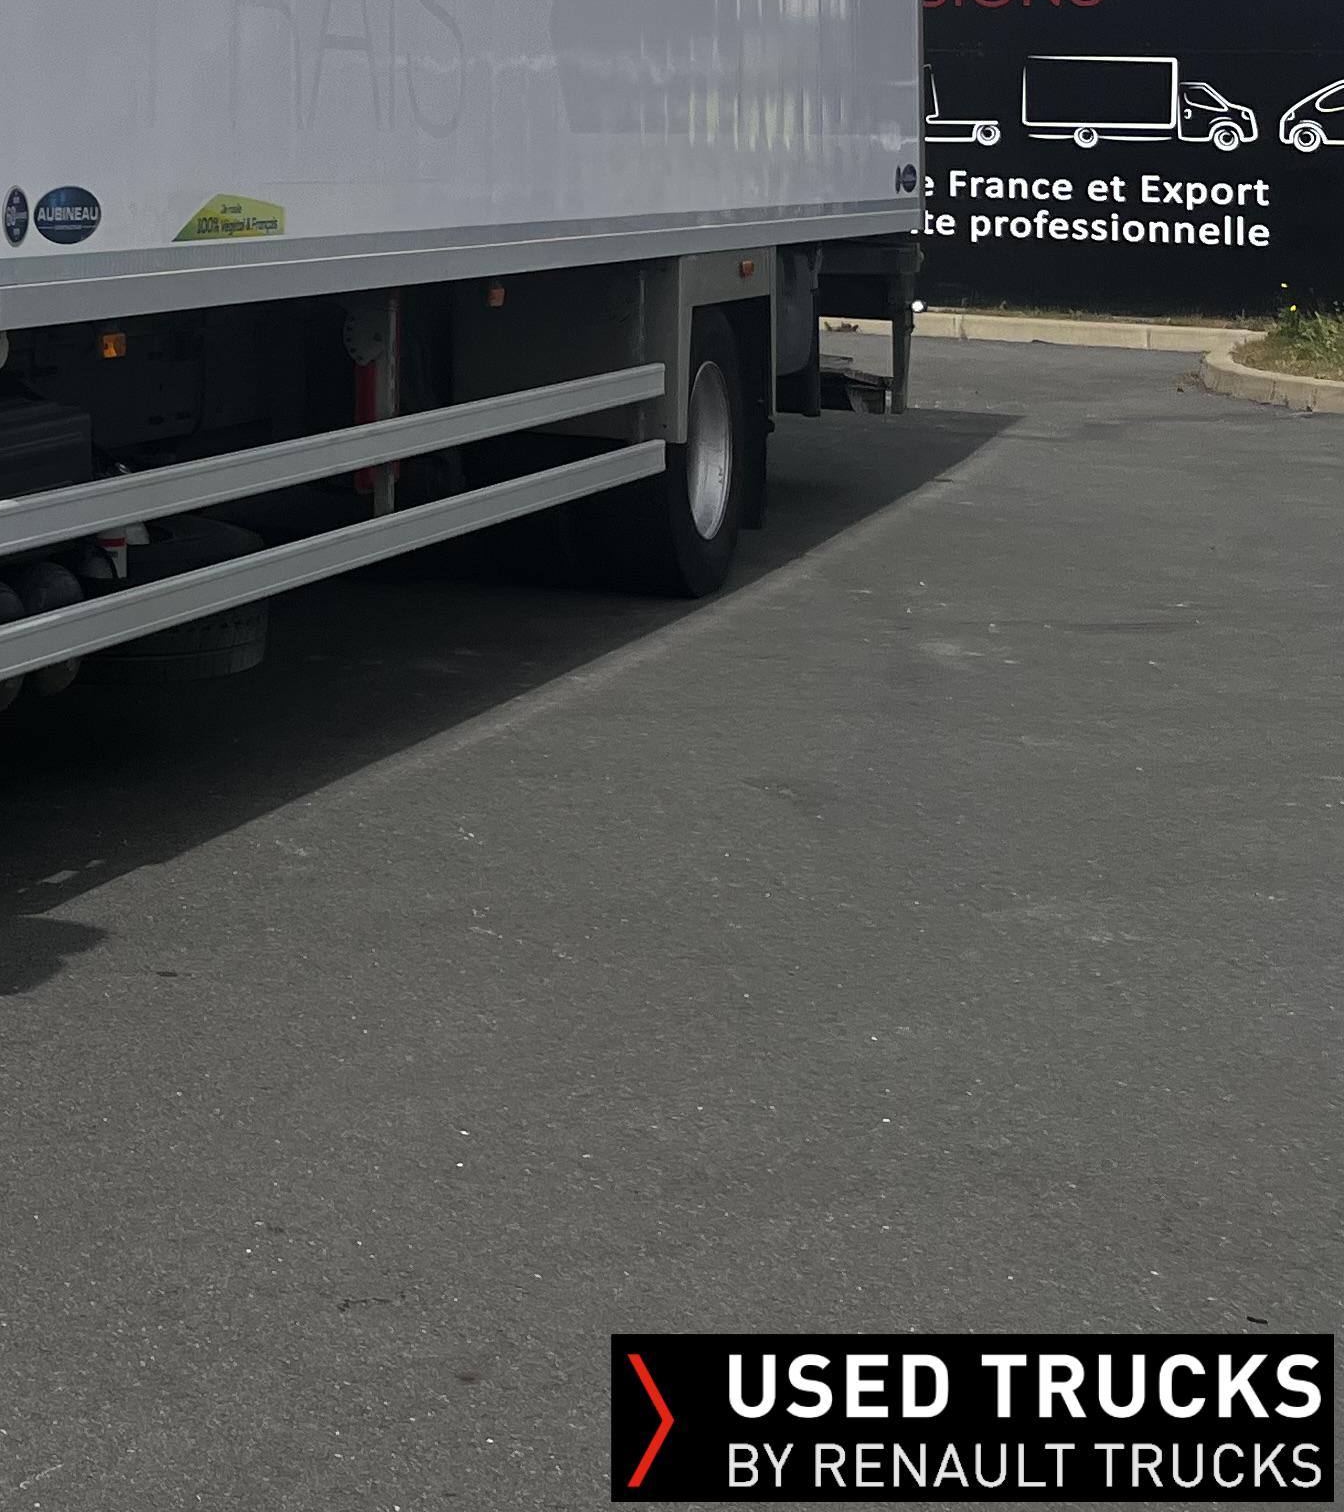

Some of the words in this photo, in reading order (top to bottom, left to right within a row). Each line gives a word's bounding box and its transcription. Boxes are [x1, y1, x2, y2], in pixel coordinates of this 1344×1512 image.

[949, 170, 1073, 201] France
[1087, 174, 1126, 201] et
[1142, 175, 1270, 210] Export
[37, 206, 100, 222] AUBINEAU
[970, 210, 1270, 247] professionnelle
